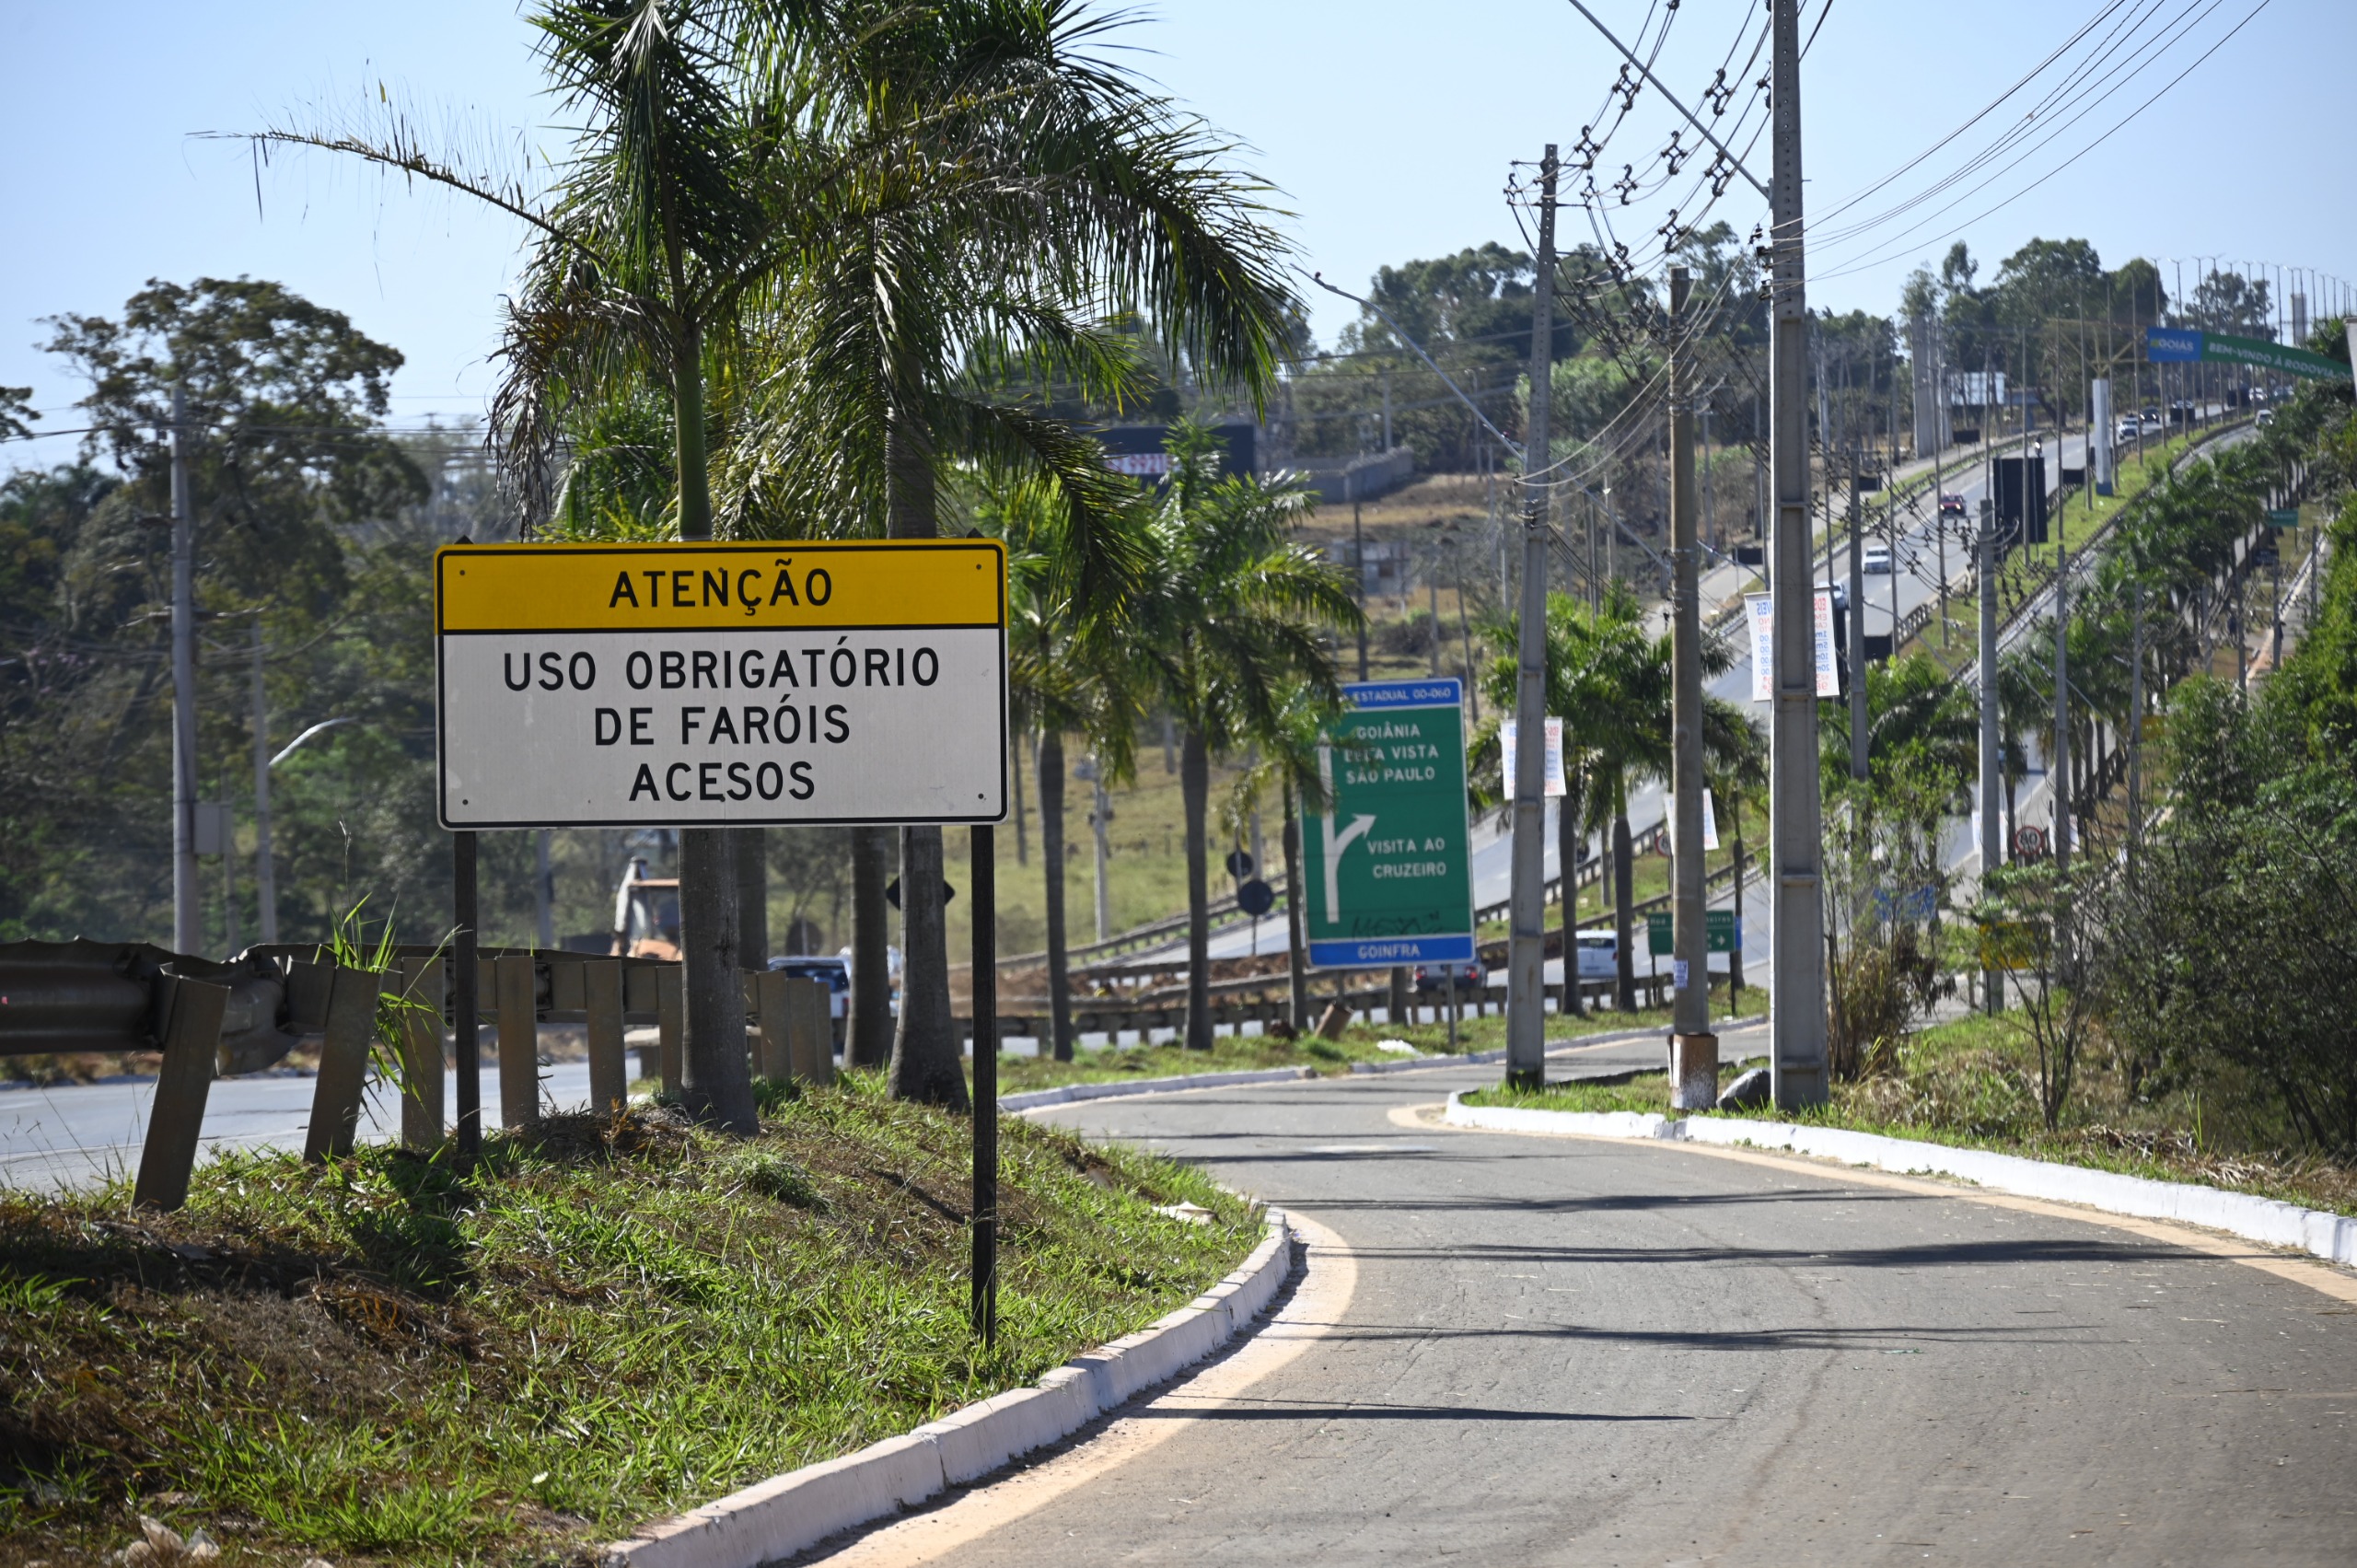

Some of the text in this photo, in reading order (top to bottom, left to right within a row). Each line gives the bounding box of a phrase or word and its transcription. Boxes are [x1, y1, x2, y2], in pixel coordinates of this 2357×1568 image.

[2209, 342, 2272, 364] BEM-VINDO
[2284, 357, 2335, 378] RODOVIA
[609, 557, 833, 617] ATENÇÃO
[504, 636, 940, 691] USO OBRIGATÓRIO
[1353, 689, 1409, 703] ESTADUAL
[595, 693, 851, 746] DE FARÓIS
[1356, 720, 1421, 740] GOIÂNIA
[1391, 744, 1439, 761] VISTA
[629, 761, 816, 802] ACESOS
[1345, 765, 1435, 784] SÃO PAULO
[1366, 837, 1446, 854] VISITA AO
[1372, 862, 1446, 878] CRUZEIRO
[1357, 943, 1422, 959] GOINFRA
